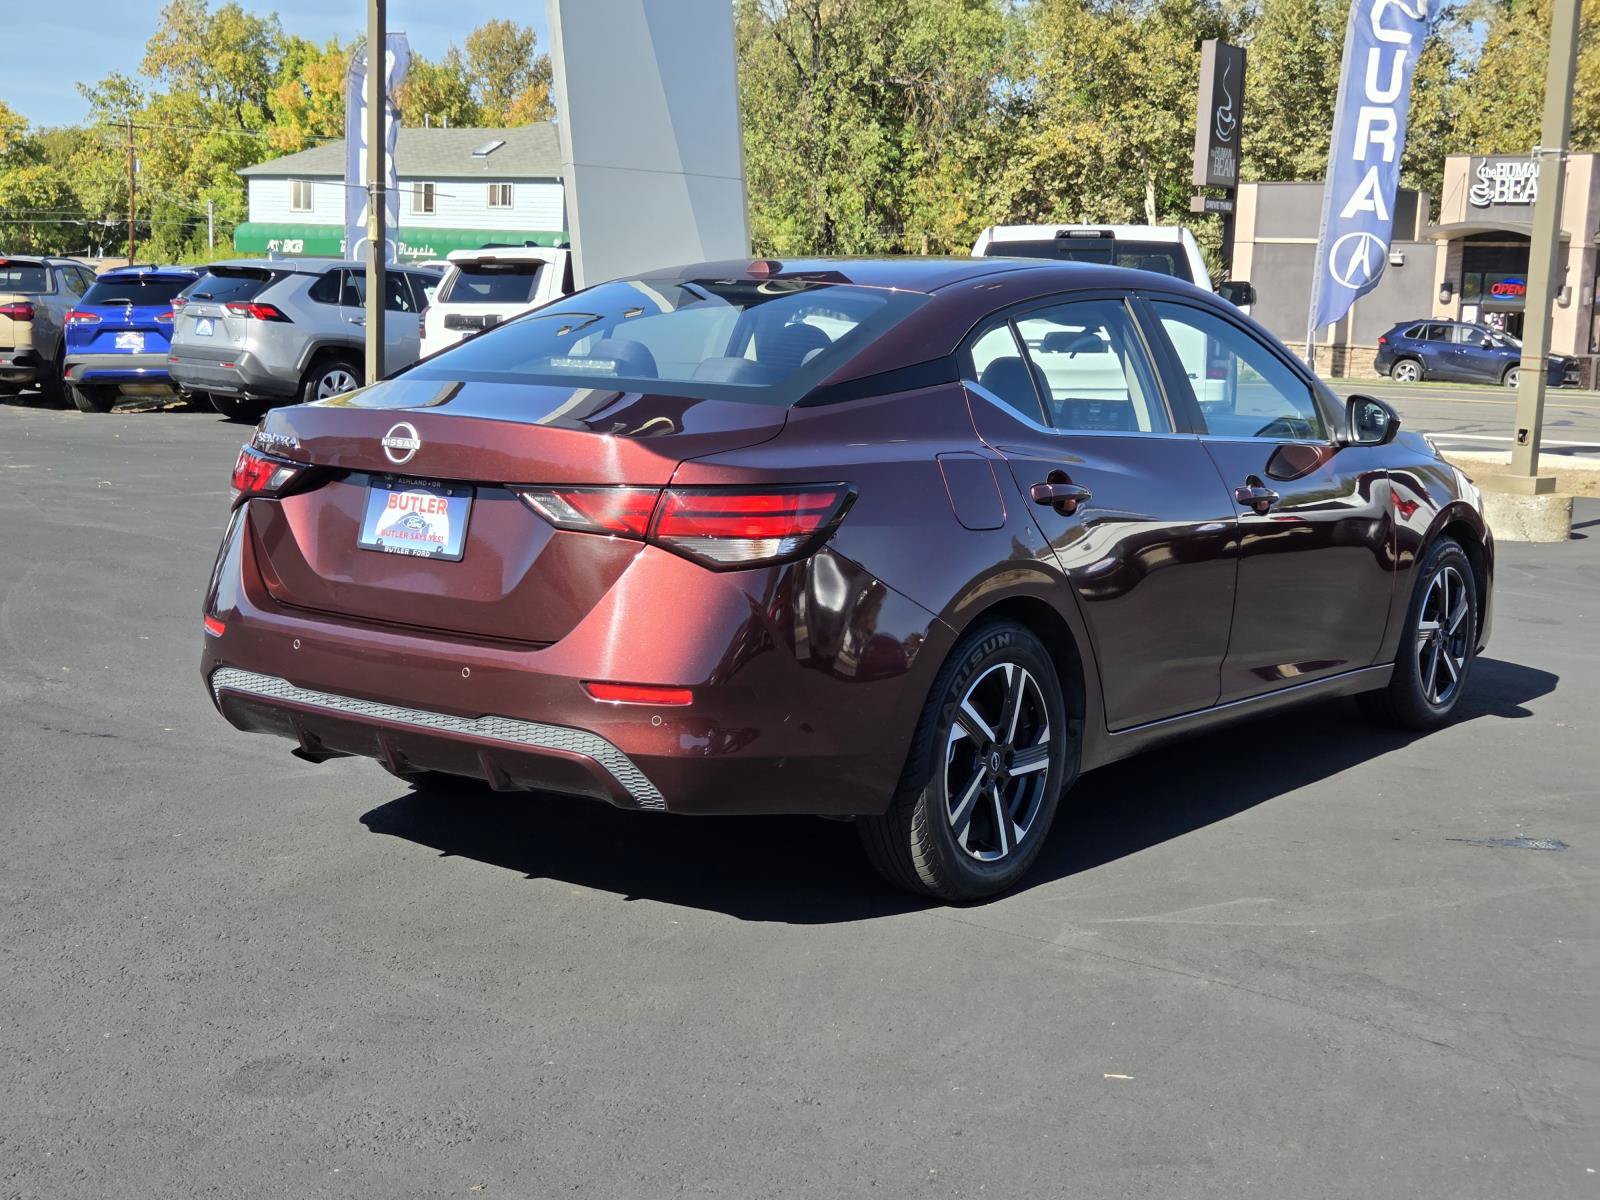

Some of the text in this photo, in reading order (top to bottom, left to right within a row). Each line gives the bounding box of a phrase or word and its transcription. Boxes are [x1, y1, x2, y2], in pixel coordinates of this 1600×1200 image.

[1215, 147, 1233, 159] HUMAN
[1213, 158, 1236, 177] BEAN
[1481, 166, 1497, 178] the
[1492, 177, 1538, 203] BEA
[1206, 200, 1220, 210] DRIVE
[1490, 283, 1527, 295] OPEN
[381, 437, 421, 450] NISSAN
[398, 478, 428, 487] ASHLAND
[388, 494, 448, 515] BUTLER
[380, 529, 444, 544] BUTLER SAYS YES!
[384, 545, 431, 558] BUTLER FORD
